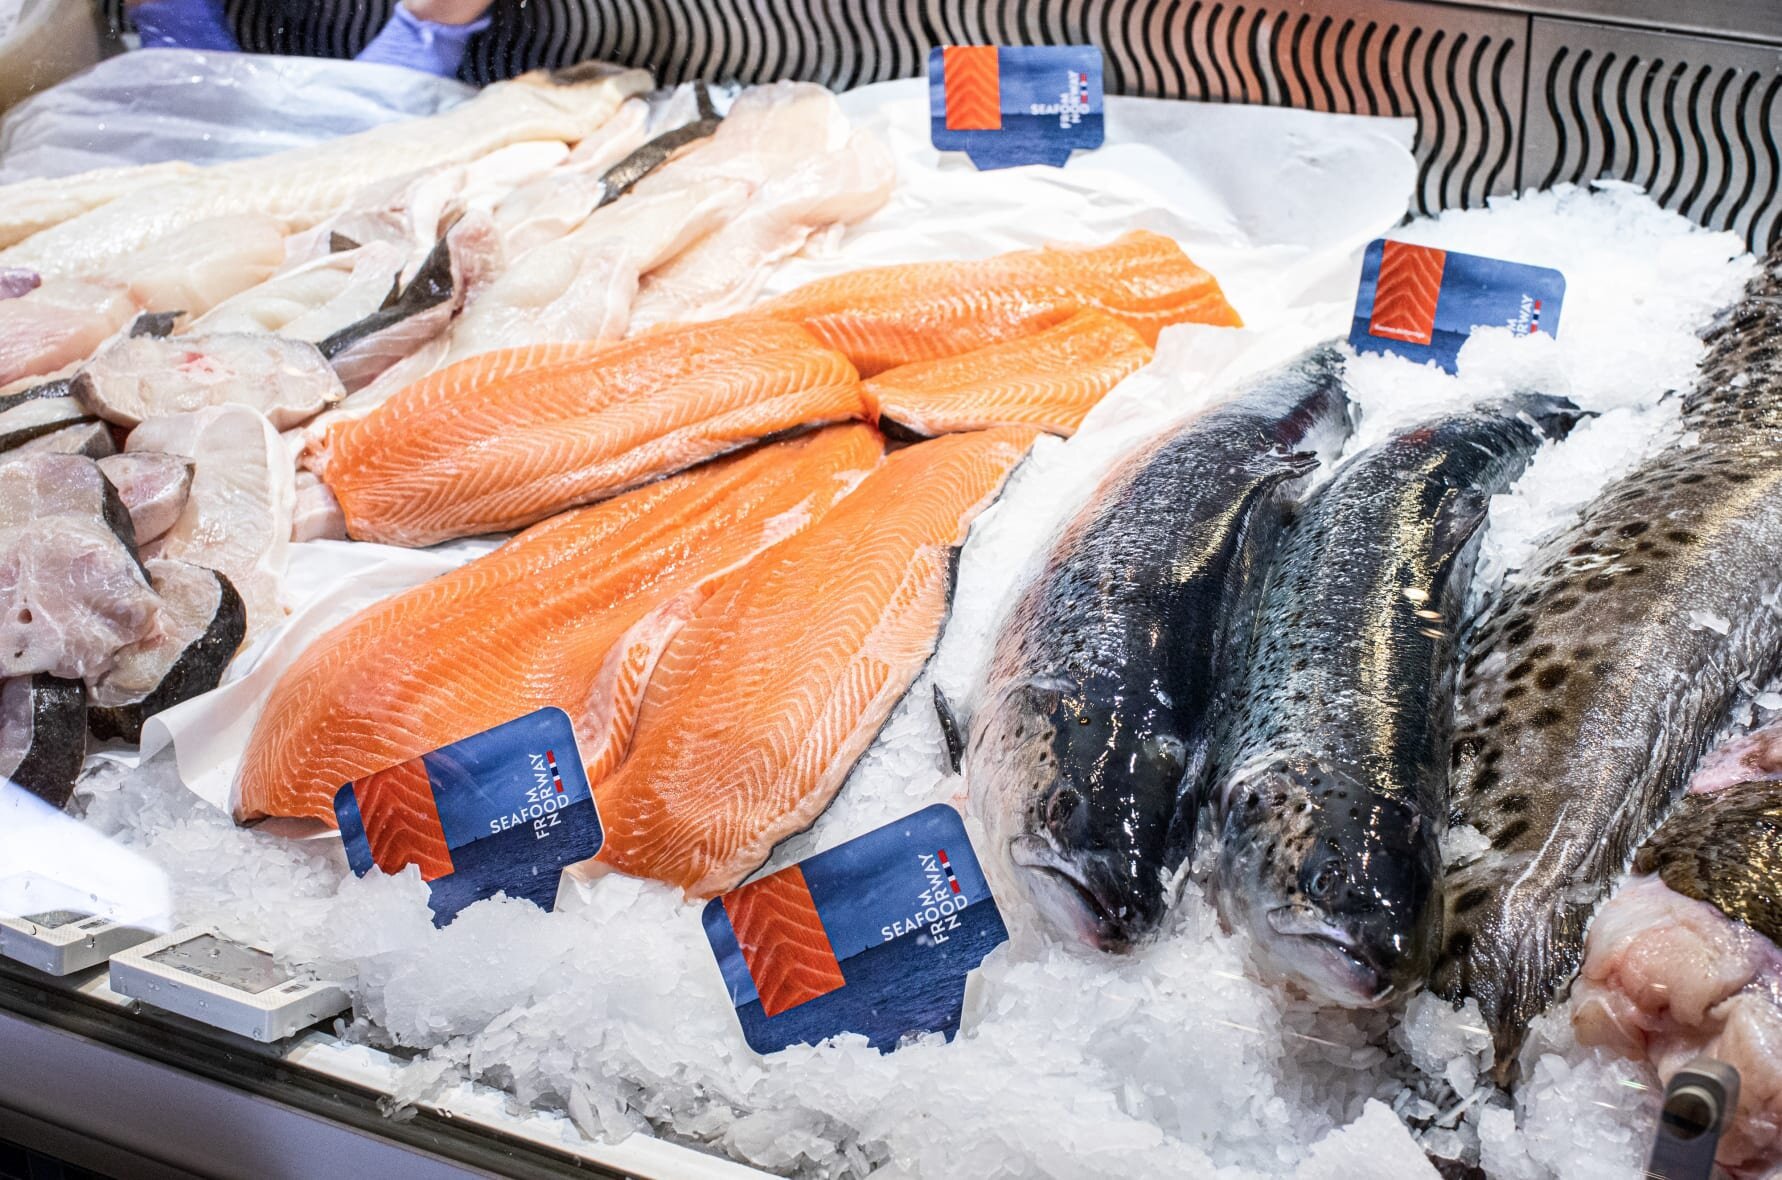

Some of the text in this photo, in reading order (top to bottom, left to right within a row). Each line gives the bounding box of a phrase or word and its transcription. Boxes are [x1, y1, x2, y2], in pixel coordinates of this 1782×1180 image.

[1514, 294, 1533, 338] RWAY
[490, 795, 569, 834] SEAFOOD
[525, 787, 550, 840] FROM
[528, 754, 561, 827] NORWAY
[881, 895, 968, 942] SEAFOOD
[917, 853, 961, 931] NORWAY
[917, 889, 949, 944] FROM
